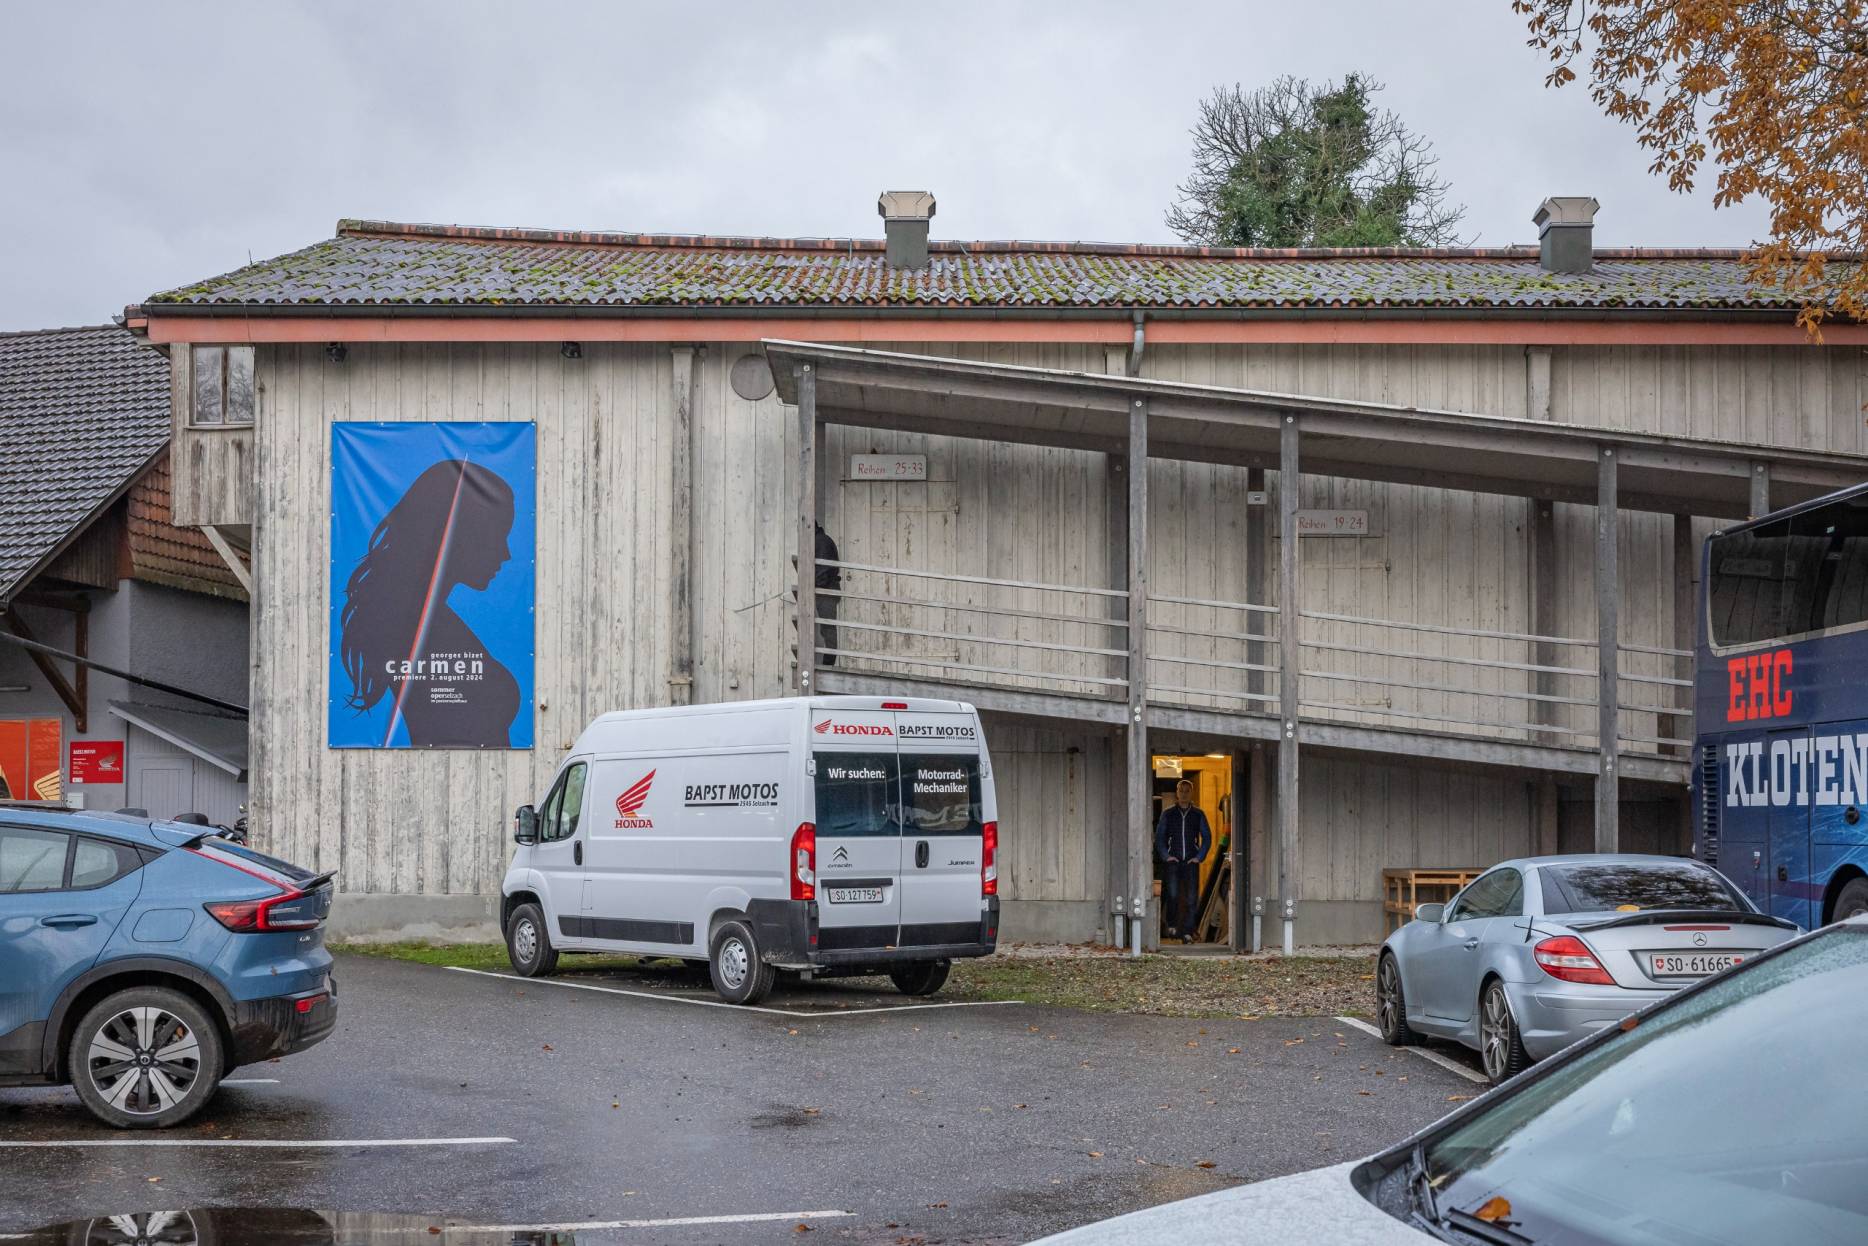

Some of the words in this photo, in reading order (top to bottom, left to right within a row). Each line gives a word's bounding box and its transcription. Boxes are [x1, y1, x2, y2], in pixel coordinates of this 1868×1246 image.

[430, 652, 461, 660] georges
[385, 660, 484, 674] carmen
[393, 674, 427, 682] premiere
[439, 674, 464, 682] august
[1727, 649, 1793, 723] EHC
[833, 724, 895, 736] HONDA
[899, 725, 934, 736] BAPST
[936, 726, 975, 737] MOTOS
[827, 767, 847, 779] Wir
[848, 767, 886, 780] suchen:
[918, 769, 966, 781] Motorrad-
[1726, 733, 1868, 807] KLOTEN
[684, 784, 727, 801] BAPST
[729, 782, 779, 800] MOTOS
[913, 782, 968, 794] Mechaniker
[614, 819, 654, 829] HONDA
